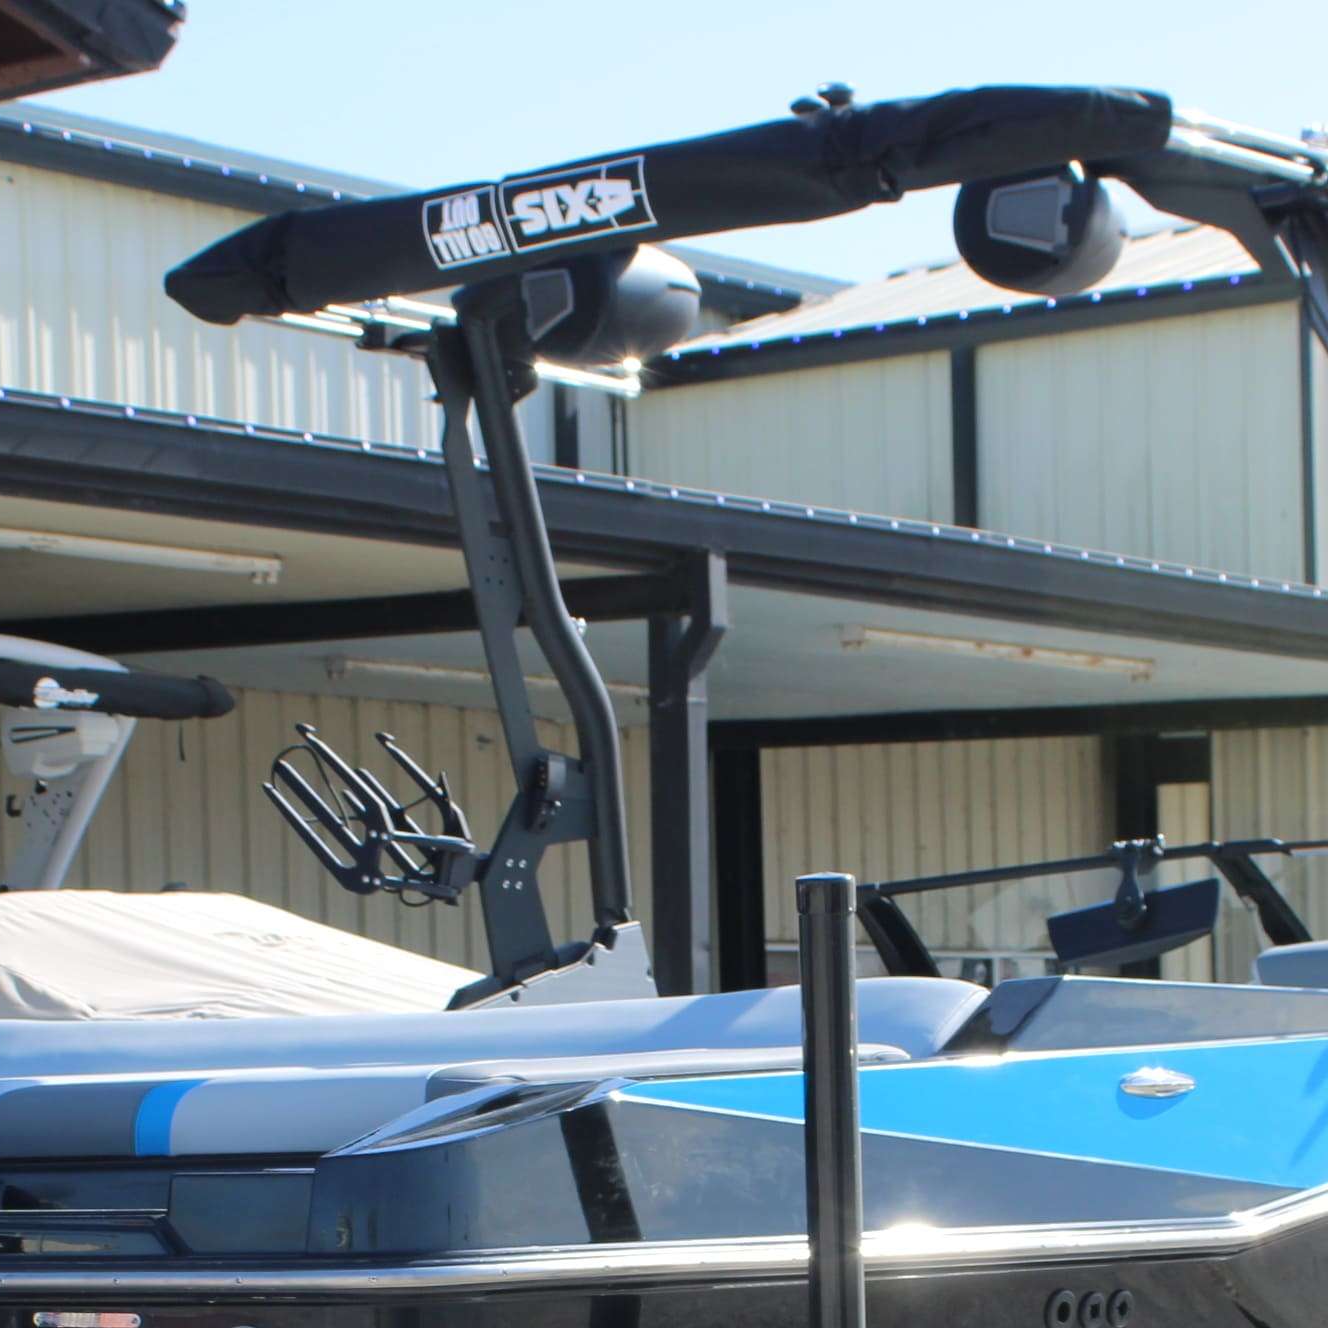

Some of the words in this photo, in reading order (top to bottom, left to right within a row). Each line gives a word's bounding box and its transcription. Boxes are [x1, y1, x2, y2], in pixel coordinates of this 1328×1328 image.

[439, 193, 480, 232] OUT
[512, 178, 636, 236] AXIS
[432, 229, 473, 262] ALL
